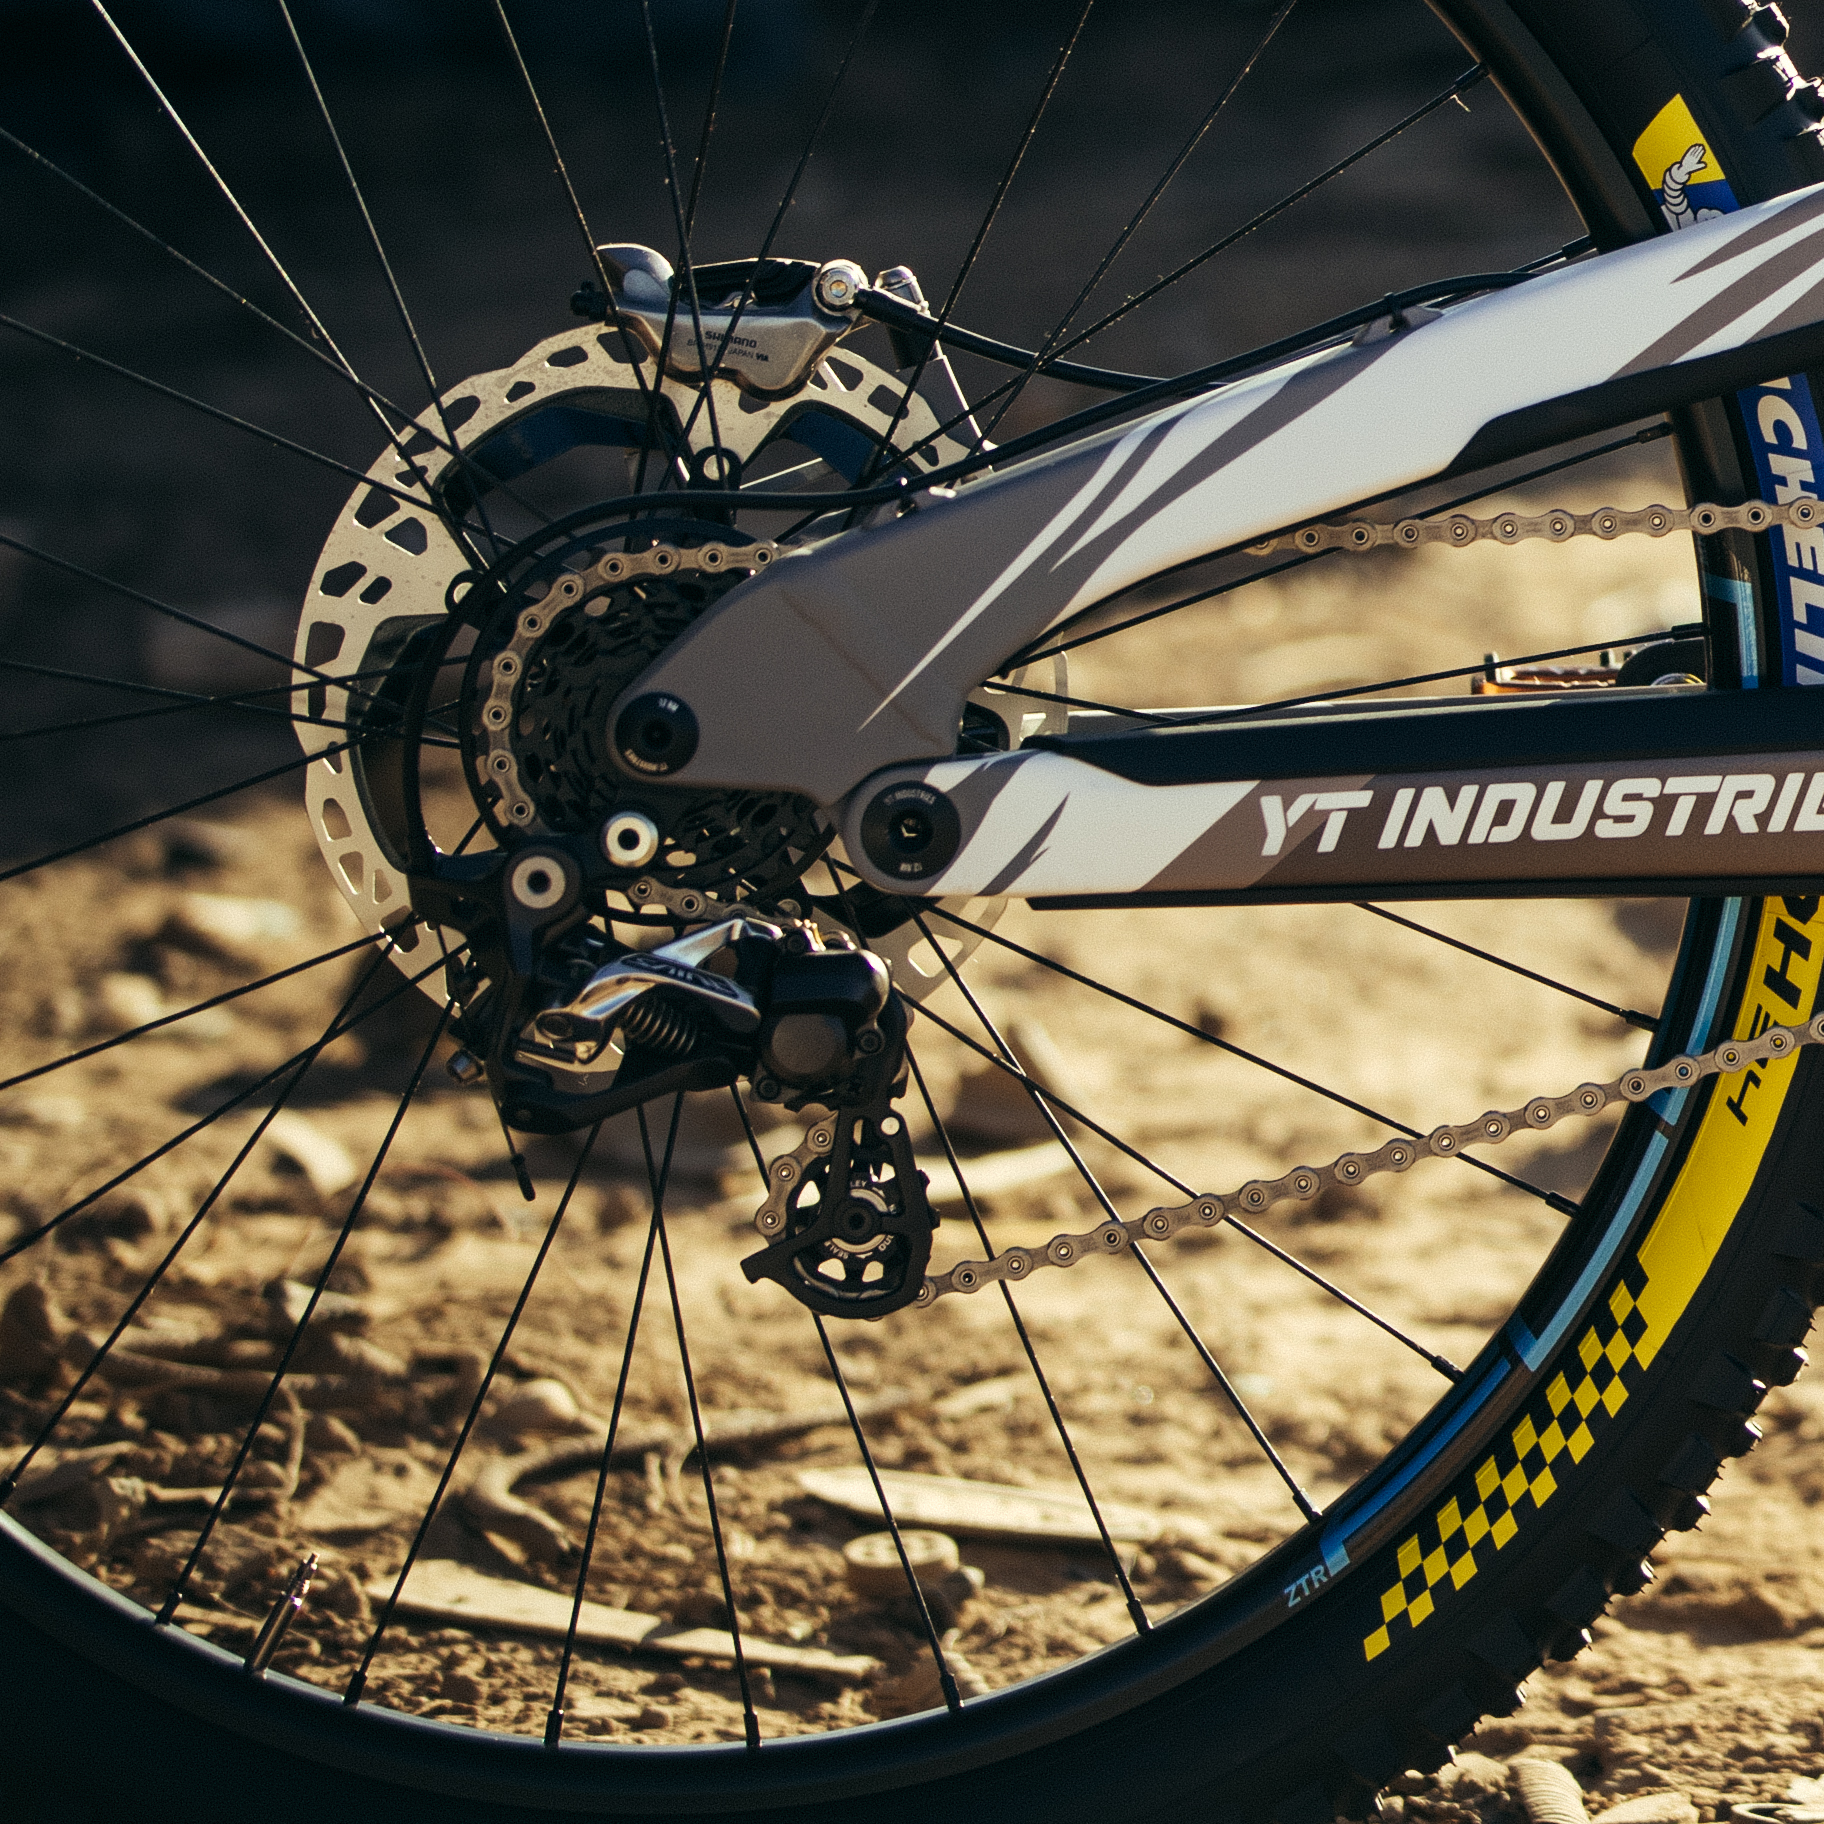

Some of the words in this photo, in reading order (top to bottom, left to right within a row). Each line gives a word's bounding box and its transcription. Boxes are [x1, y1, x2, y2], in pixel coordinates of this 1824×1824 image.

[705, 331, 757, 349] SHIANO
[1259, 790, 1374, 857] YT
[1283, 1564, 1330, 1609] ZTR
